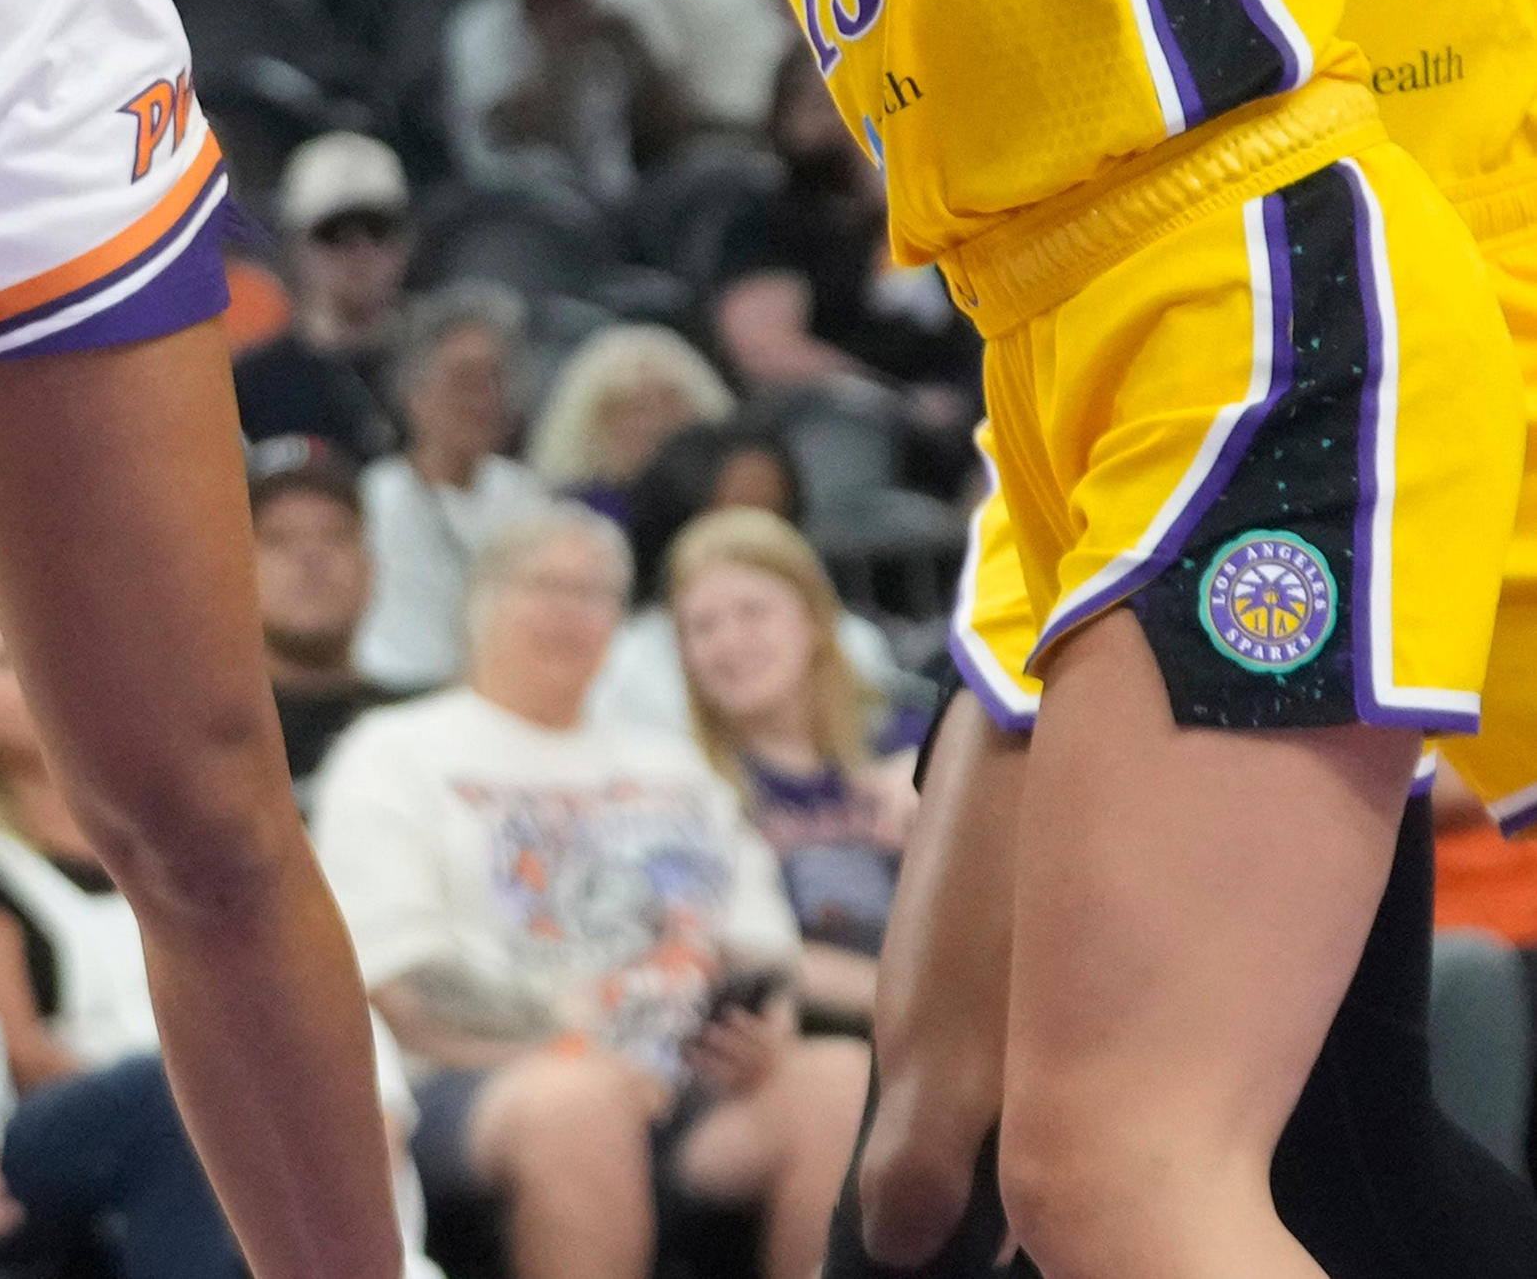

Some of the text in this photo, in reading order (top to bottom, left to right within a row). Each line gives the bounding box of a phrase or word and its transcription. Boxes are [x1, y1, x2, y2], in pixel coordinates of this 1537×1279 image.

[1365, 45, 1465, 95] ealth
[1211, 542, 1327, 611] LOS ANGELES
[1225, 628, 1312, 661] SPARKS
